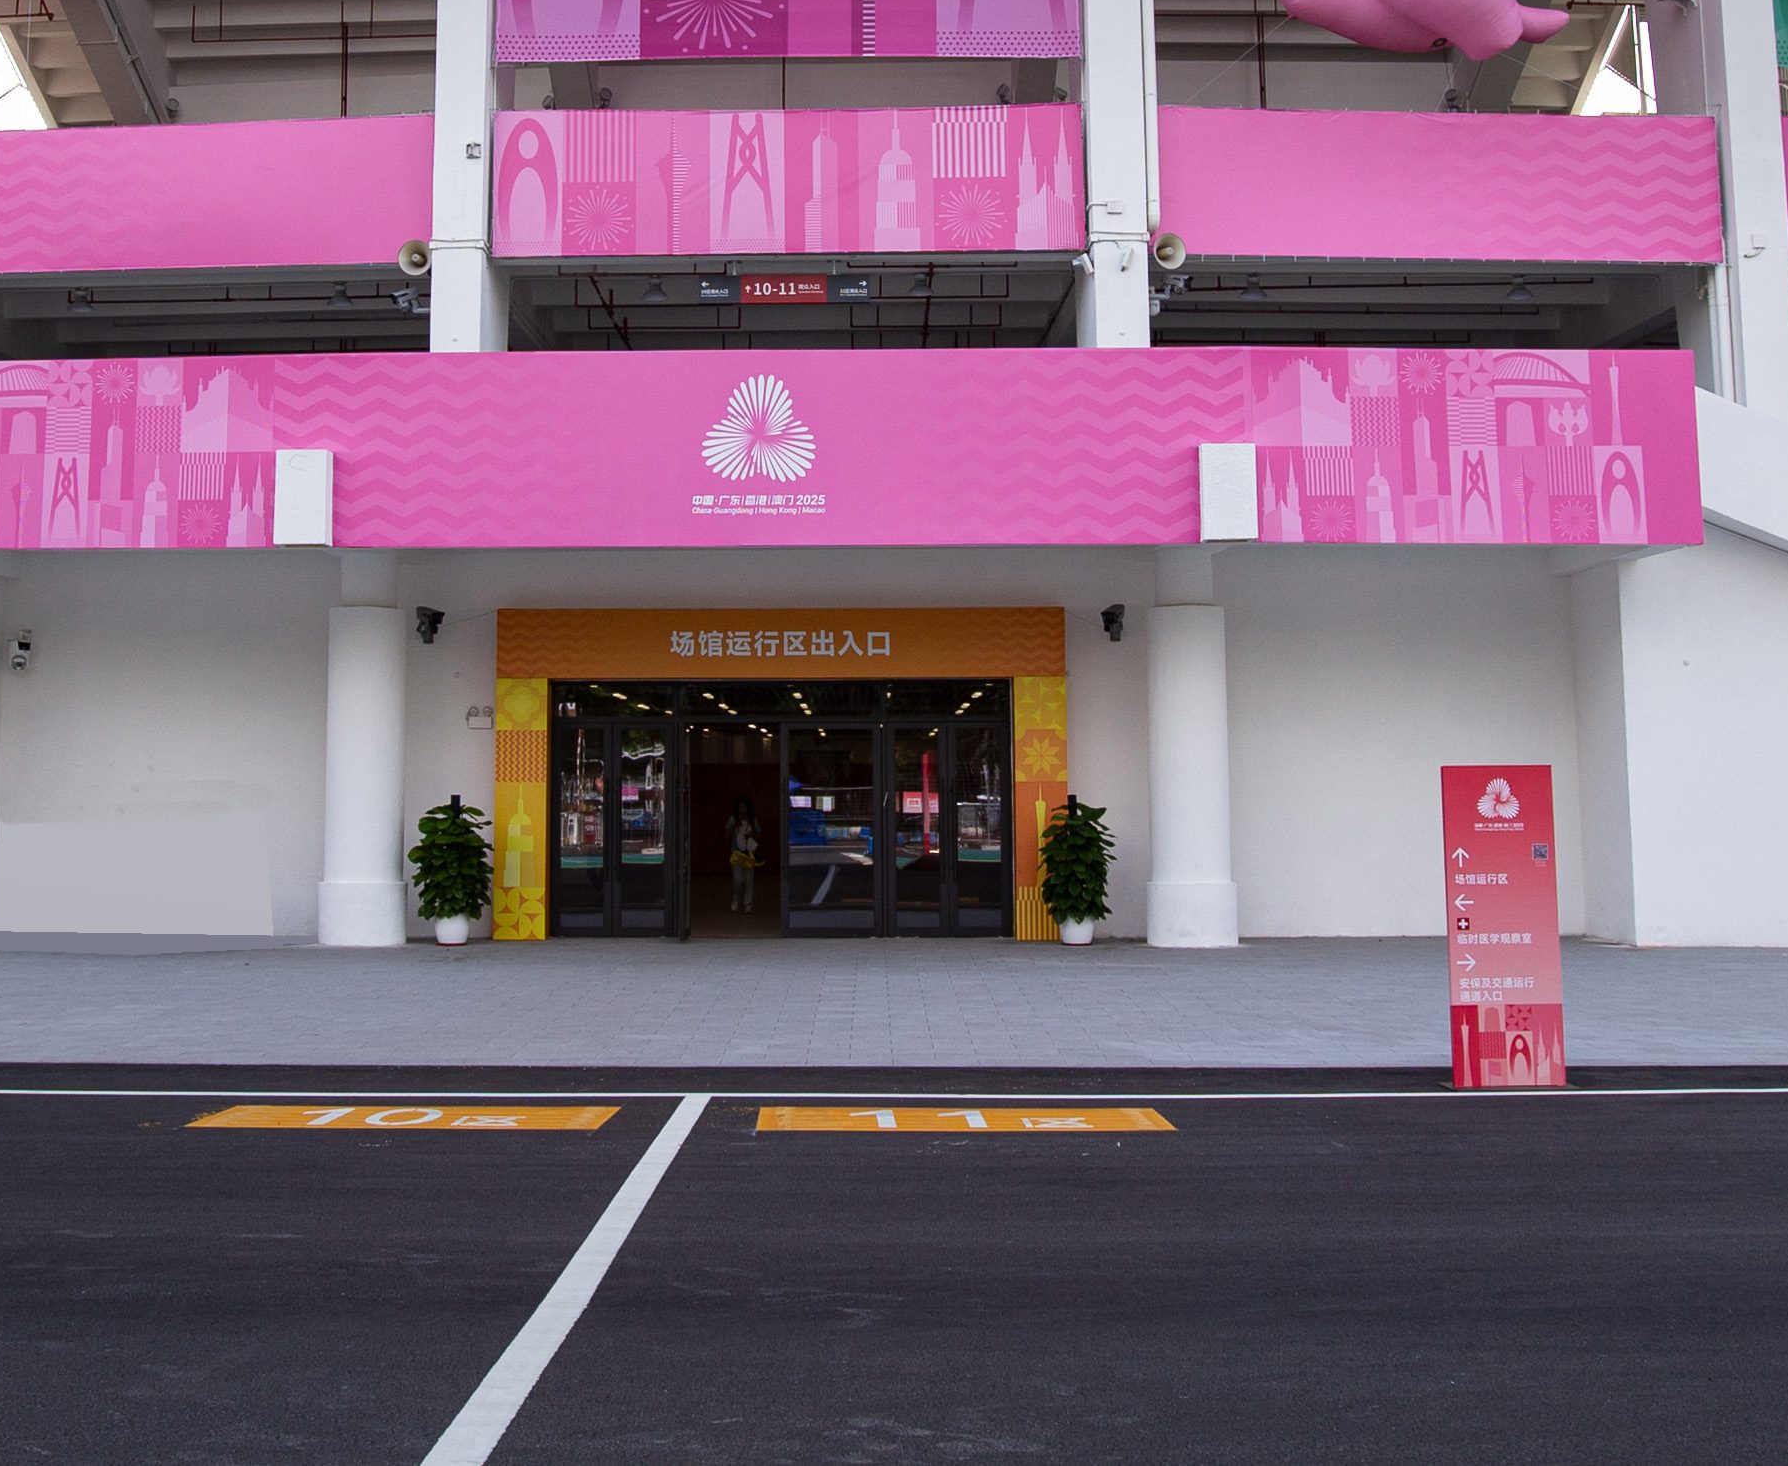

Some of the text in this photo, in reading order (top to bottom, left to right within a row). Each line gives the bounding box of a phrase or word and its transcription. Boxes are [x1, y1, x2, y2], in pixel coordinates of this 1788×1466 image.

[753, 282, 797, 295] 10-11
[796, 494, 826, 505] 2025
[670, 629, 892, 657] 场馆运行区出入口
[1454, 873, 1509, 885] 场馆运行区
[1457, 933, 1532, 945] 临时医学观察室
[1459, 977, 1534, 989] 安保及交通运行
[303, 1107, 529, 1127] 10区
[849, 1109, 1094, 1128] 11区
